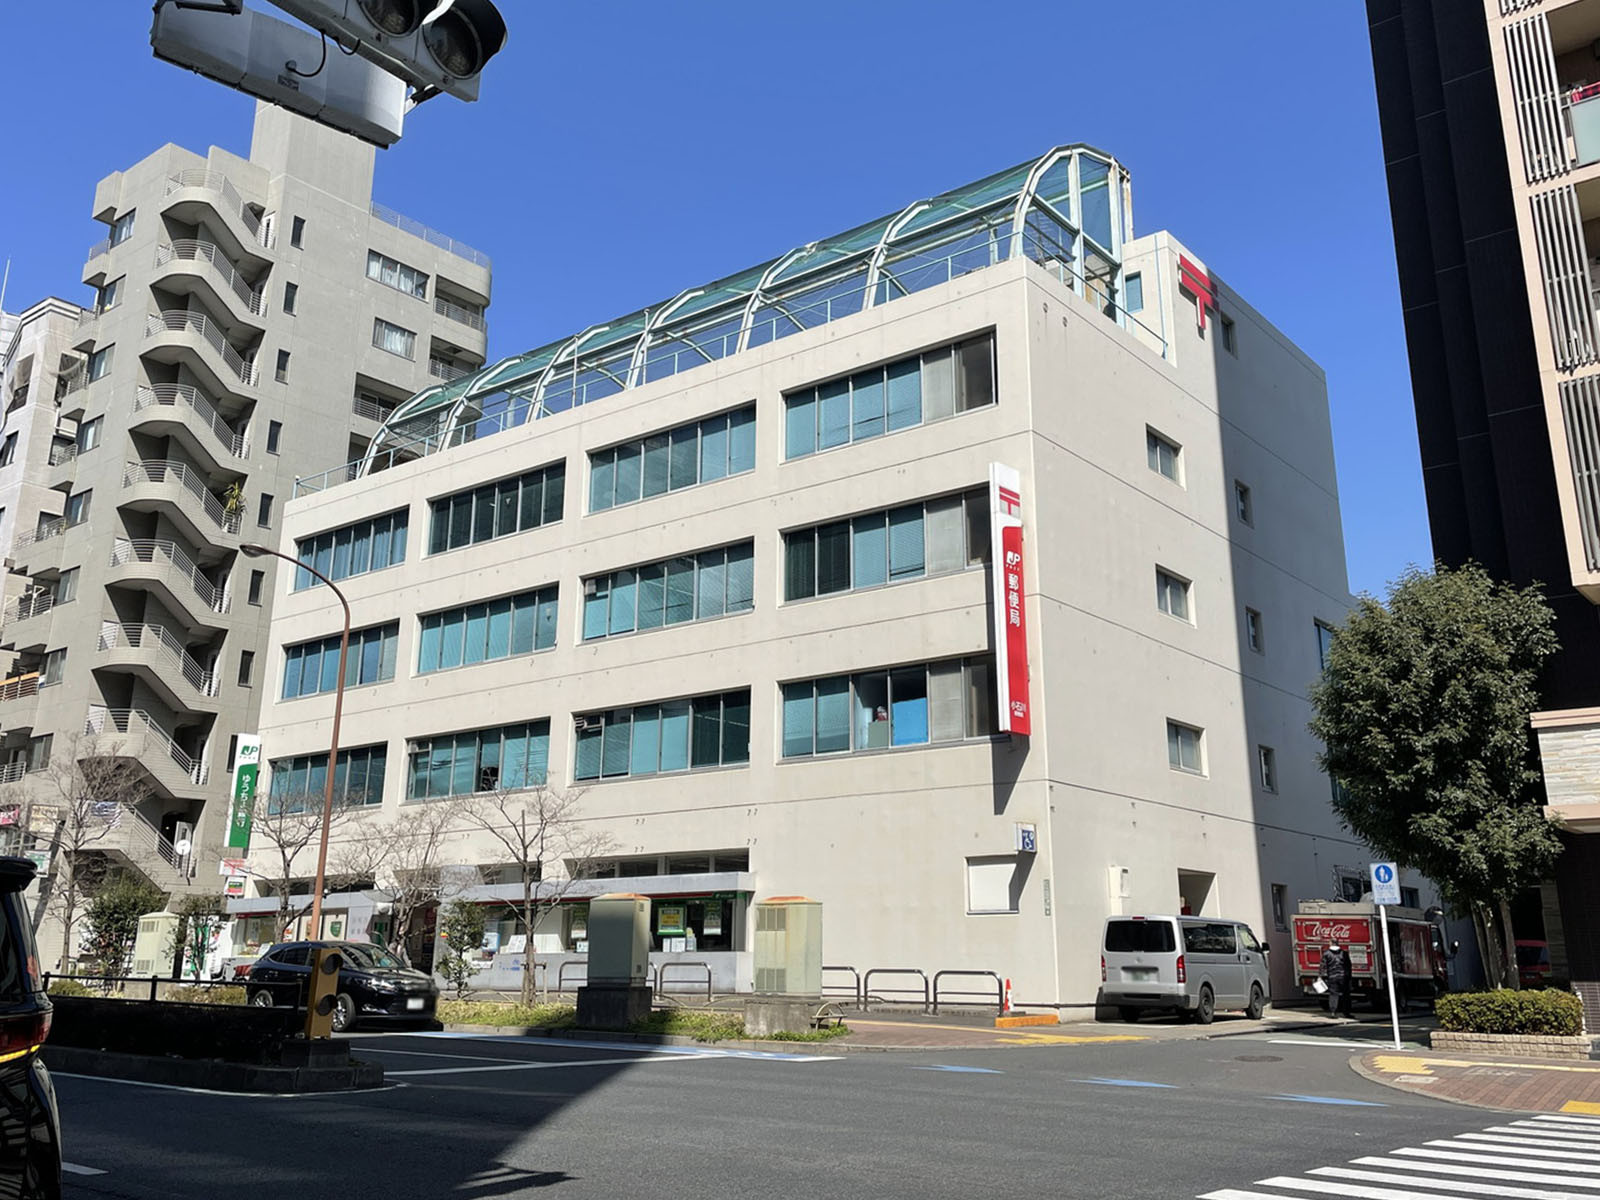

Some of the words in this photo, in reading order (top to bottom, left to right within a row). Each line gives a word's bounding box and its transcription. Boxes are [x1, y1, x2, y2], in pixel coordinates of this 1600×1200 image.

[1008, 573, 1020, 627] 郵便局
[236, 774, 252, 828] ゆうちょ銀行
